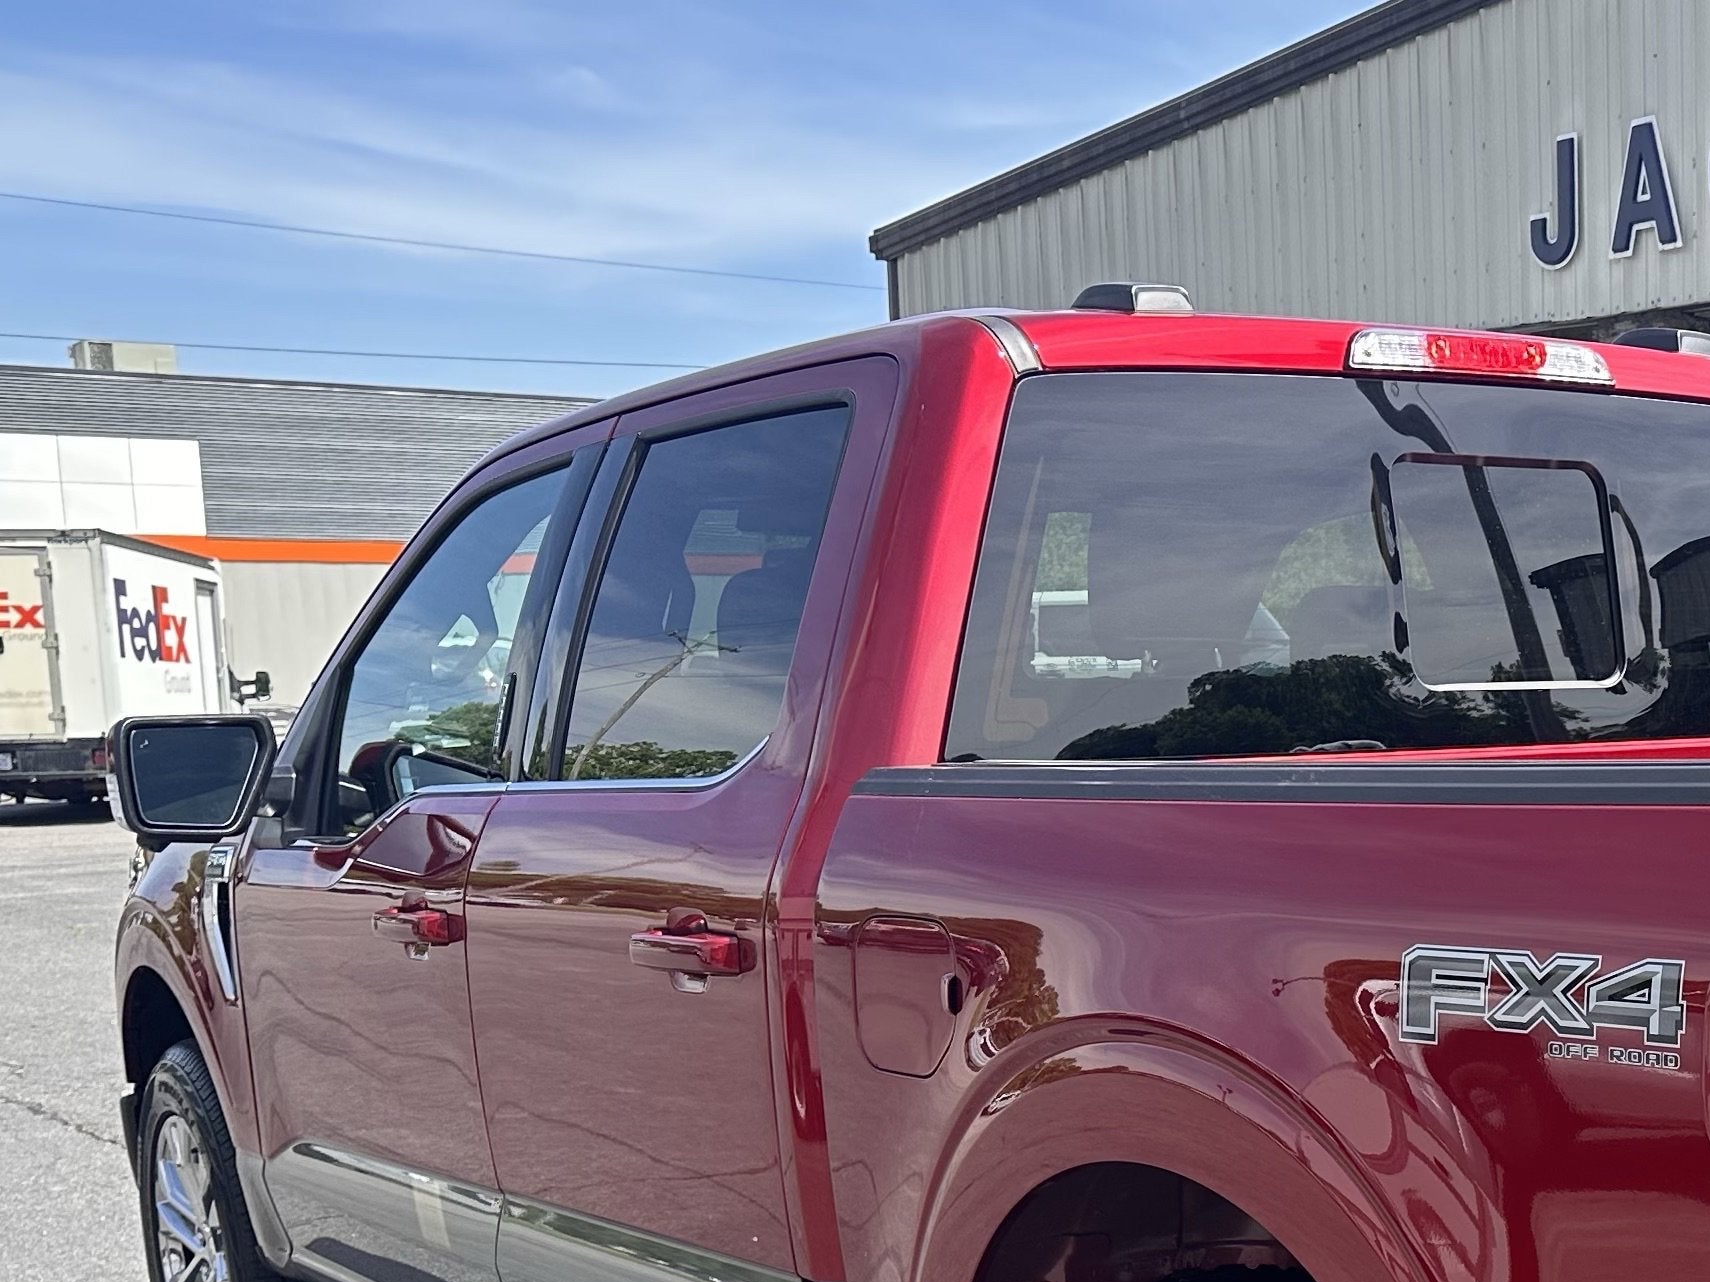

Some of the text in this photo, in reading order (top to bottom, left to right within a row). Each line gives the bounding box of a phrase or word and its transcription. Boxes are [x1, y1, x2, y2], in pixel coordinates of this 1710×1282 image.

[112, 577, 193, 665] FedEx
[1399, 943, 1686, 1048] FX4
[1548, 1041, 1681, 1071] OFF ROAD
